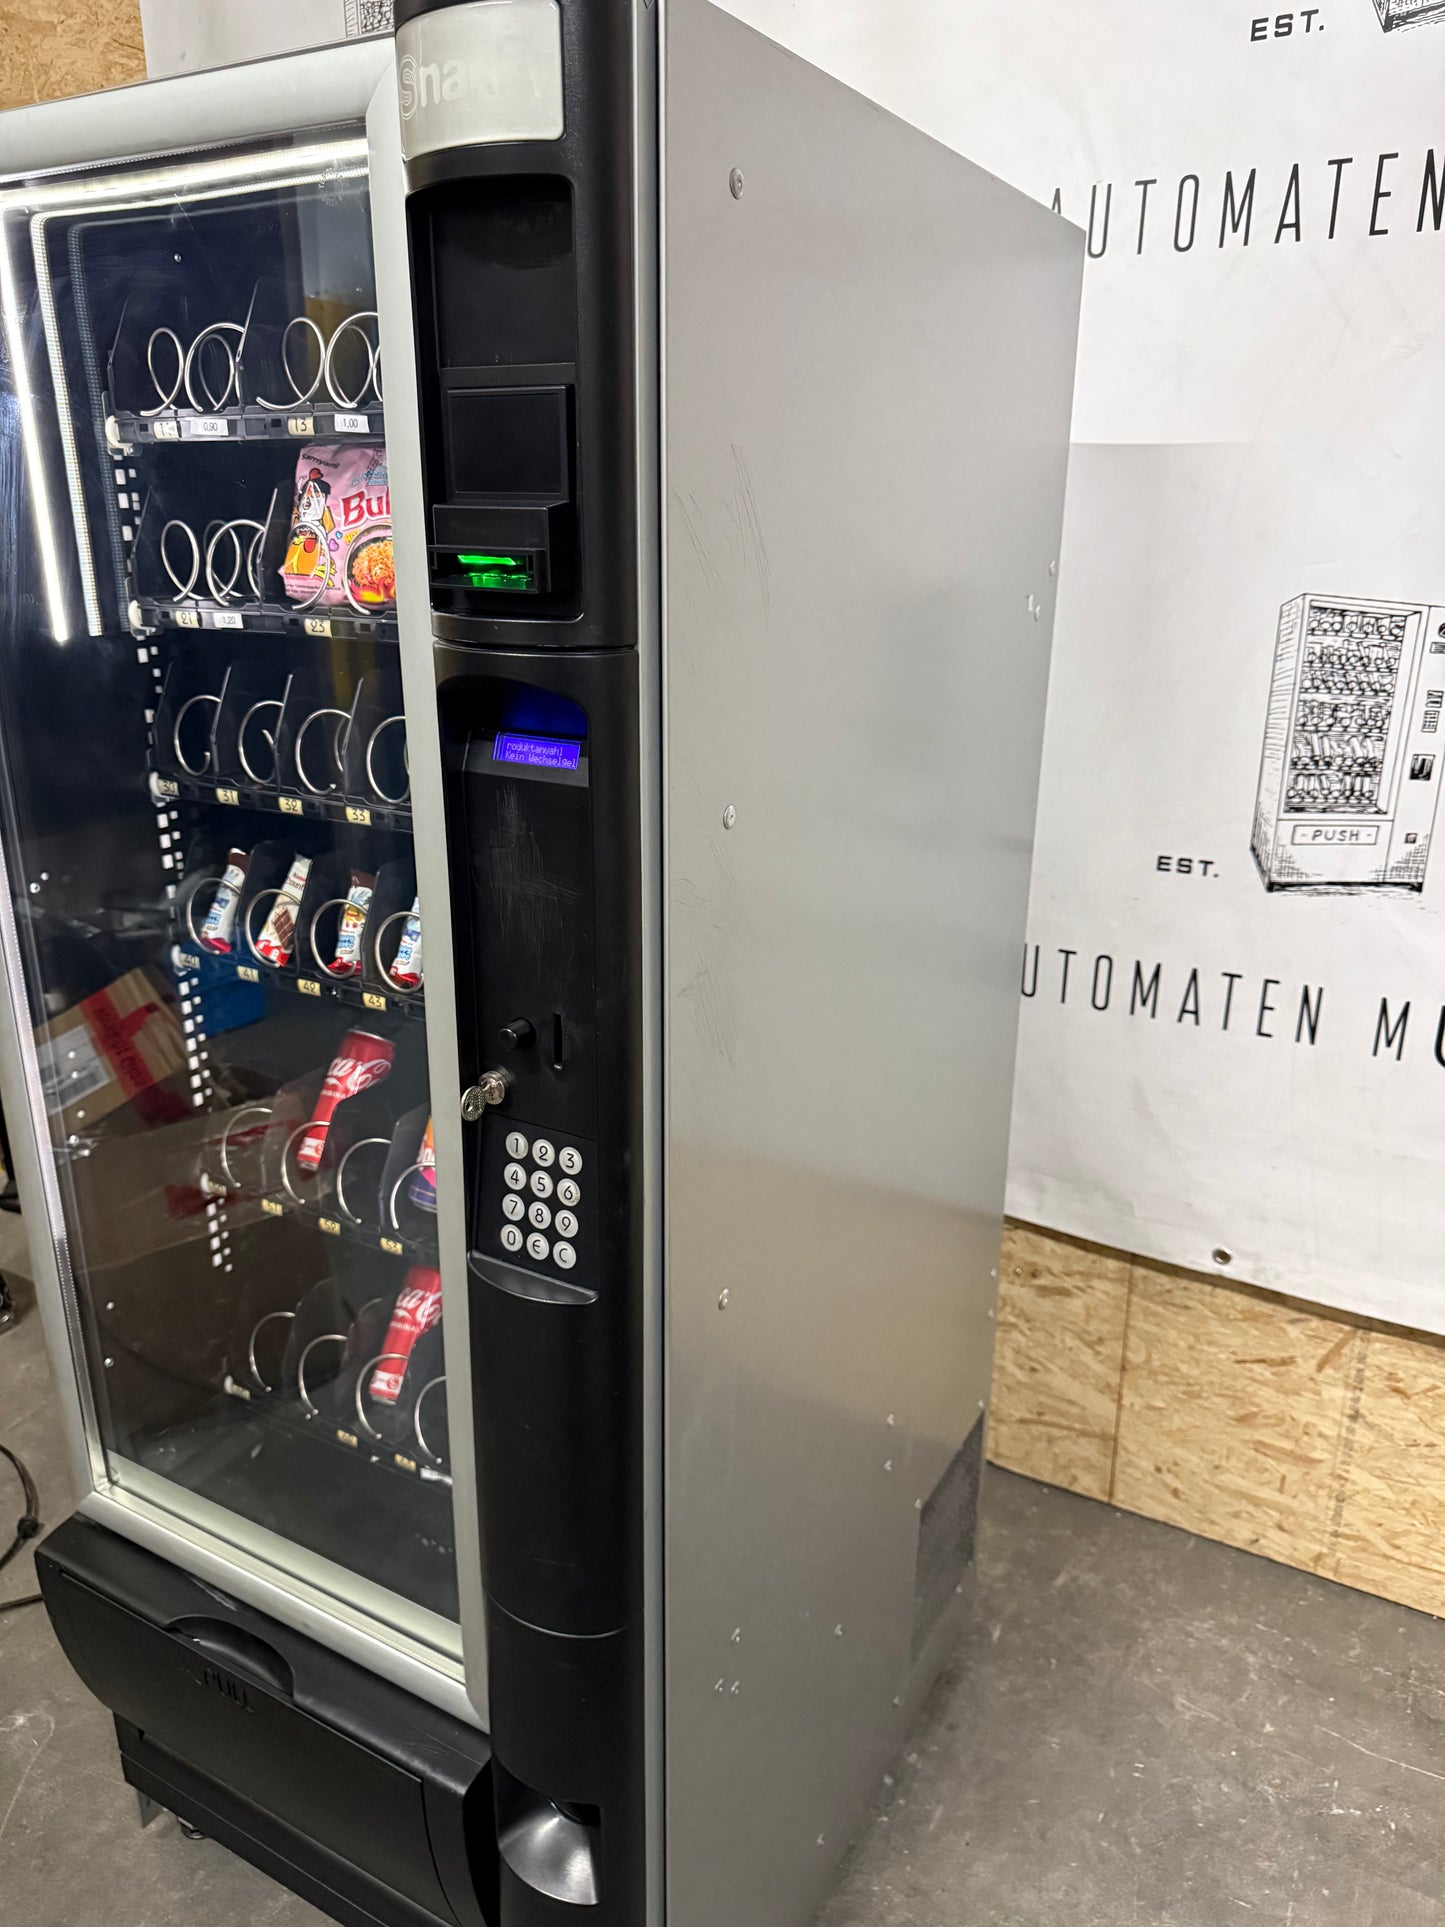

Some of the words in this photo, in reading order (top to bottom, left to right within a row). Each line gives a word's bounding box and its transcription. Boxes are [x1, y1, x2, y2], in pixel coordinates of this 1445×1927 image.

[1250, 8, 1325, 42] EST.
[295, 416, 308, 433] 13
[180, 612, 193, 625] 21
[310, 620, 325, 633] 23
[505, 750, 525, 761] Kein
[163, 780, 175, 794] 30
[222, 791, 235, 803] 31
[284, 799, 298, 812] 32
[352, 809, 366, 822] 33
[1311, 829, 1360, 842] PUSH
[1156, 855, 1219, 878] EST.
[242, 968, 254, 979] 41
[302, 980, 316, 993] 42
[368, 994, 382, 1007] 43
[538, 1145, 548, 1162] 2
[565, 1152, 575, 1169] 3
[510, 1169, 519, 1184] 4
[537, 1176, 545, 1192] 5
[563, 1185, 573, 1200] 6
[509, 1198, 518, 1214] 7
[534, 1207, 544, 1223] 8
[561, 1216, 571, 1231] 9
[506, 1230, 516, 1246] 0
[559, 1247, 568, 1263] C
[203, 1667, 256, 1715] PULL
